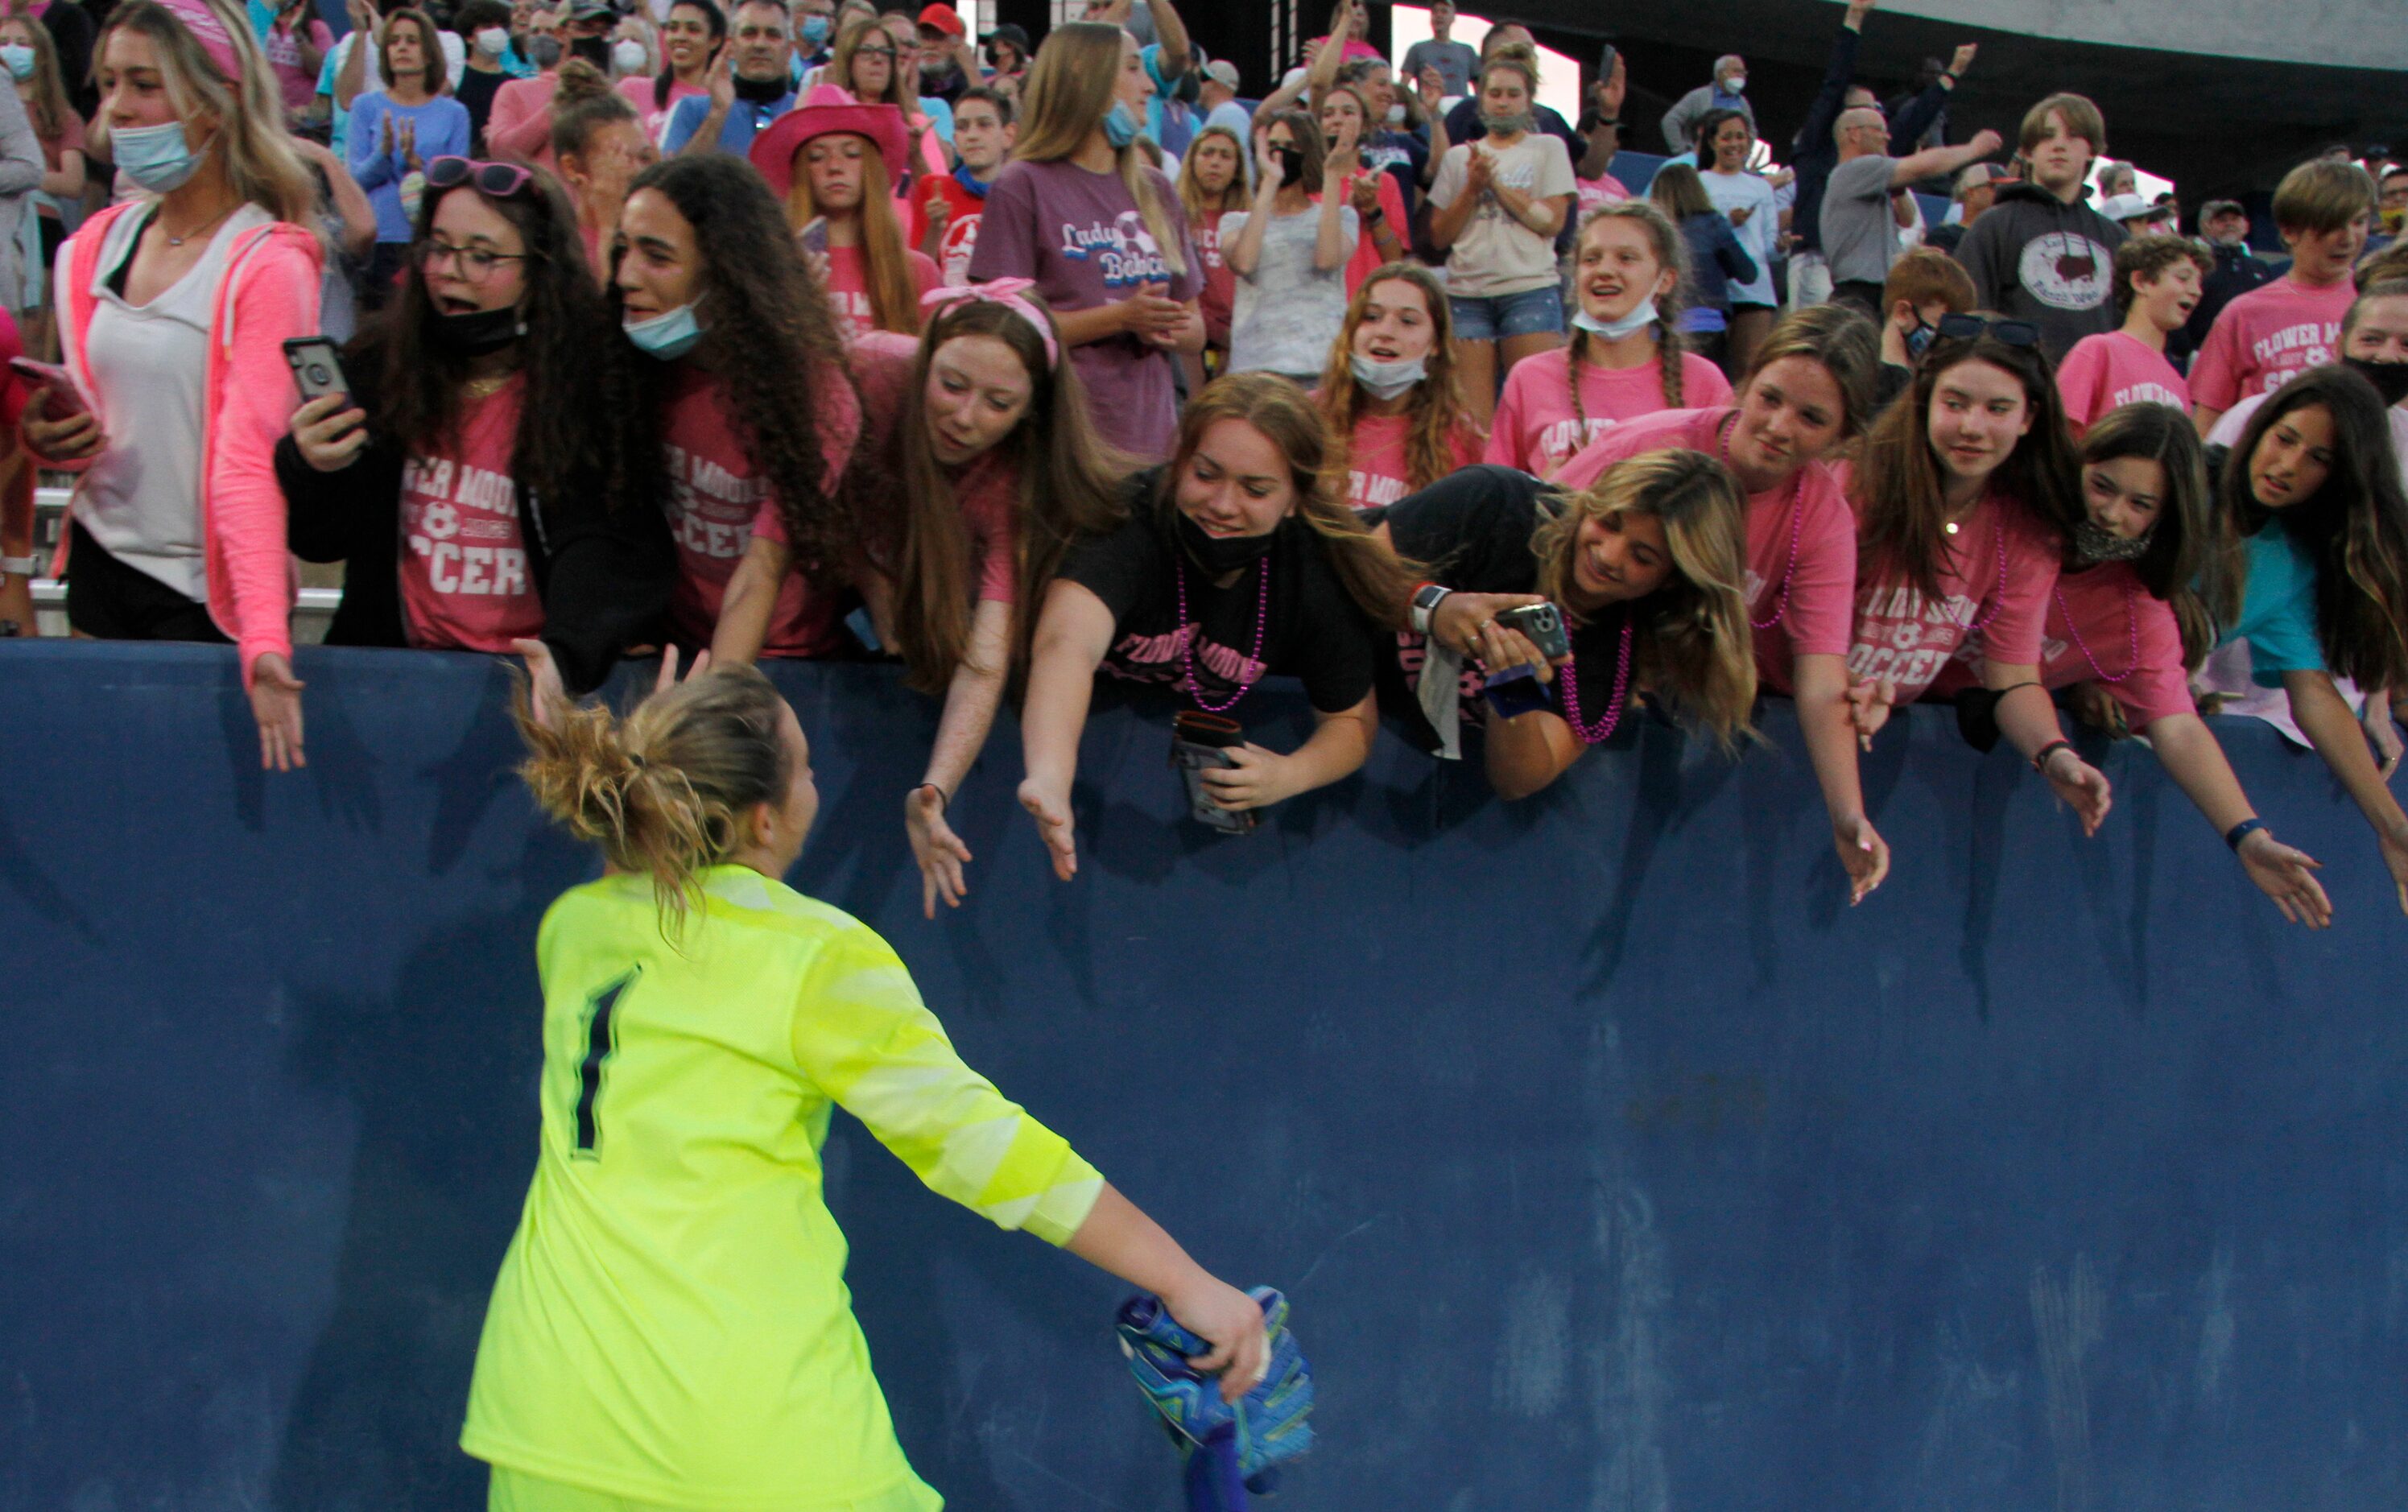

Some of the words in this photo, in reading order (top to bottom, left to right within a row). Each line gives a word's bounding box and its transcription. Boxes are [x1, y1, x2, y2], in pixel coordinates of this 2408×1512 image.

[1062, 221, 1123, 259] Lady
[2253, 324, 2319, 363] FLOWER
[569, 962, 642, 1164] 1
